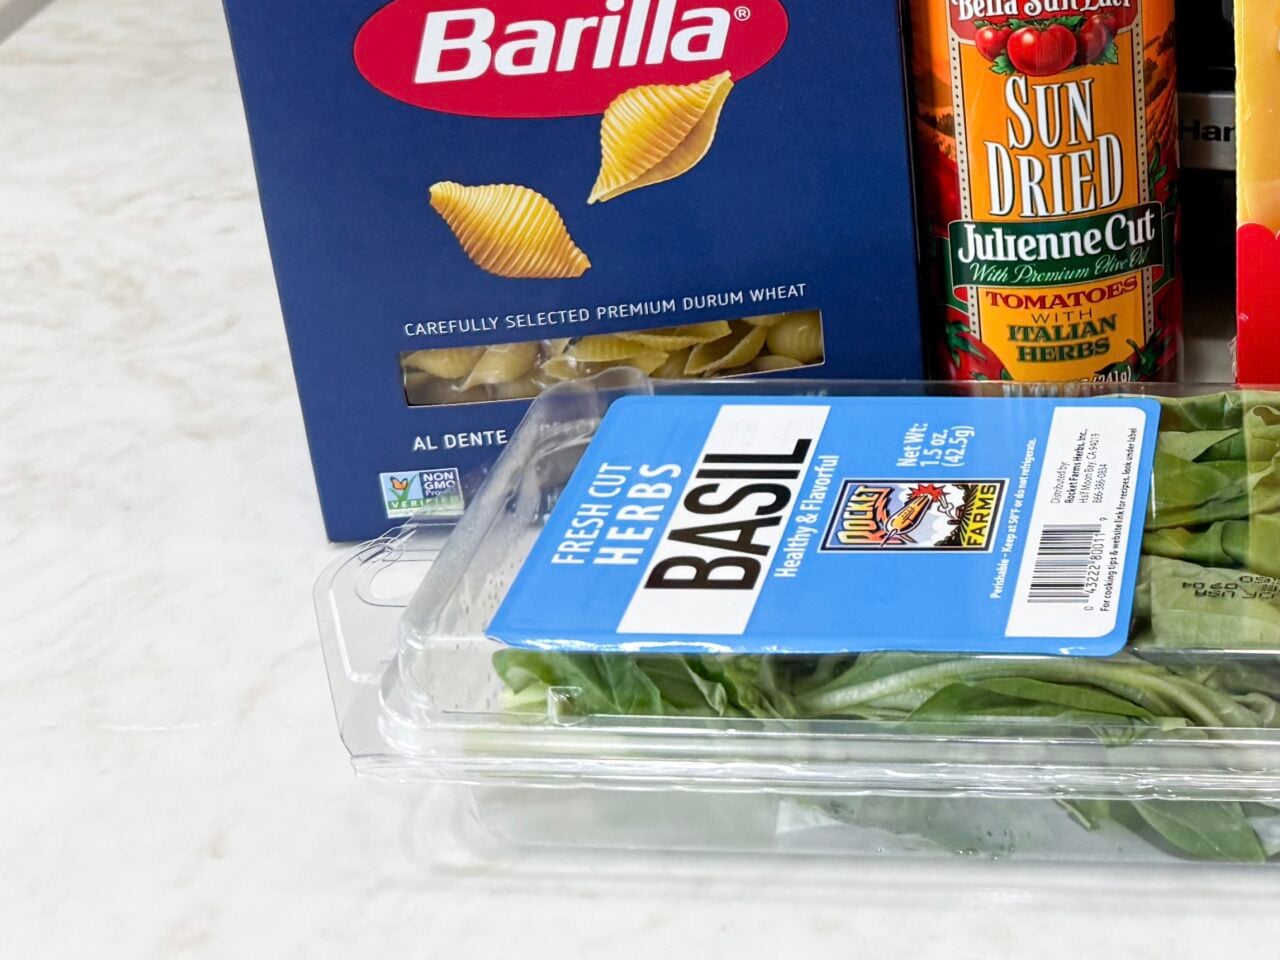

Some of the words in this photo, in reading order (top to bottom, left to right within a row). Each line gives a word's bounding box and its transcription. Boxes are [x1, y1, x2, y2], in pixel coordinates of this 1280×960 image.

[1003, 74, 1095, 150] SUN
[983, 133, 1125, 218] DRIED
[957, 222, 1104, 264] Julienne
[1104, 209, 1156, 250] Cut
[968, 262, 1009, 283] With
[1009, 263, 1090, 285] Premium
[985, 275, 1138, 310] TOMATOES
[404, 316, 500, 337] CAREFULLY
[505, 307, 590, 329] SELECTED
[596, 298, 677, 320] PREMIUM
[682, 290, 745, 310] DURUM
[749, 283, 807, 303] WHEAT
[1031, 308, 1093, 324] WITH
[1007, 313, 1119, 343] ITALIAN
[1016, 336, 1111, 364] HERBS
[413, 434, 441, 451] AL
[444, 429, 509, 448] DENTE
[930, 429, 949, 447] oz.
[941, 425, 976, 468] (42.5g)
[896, 445, 922, 468] Net
[920, 448, 944, 468] 1.5
[423, 471, 454, 481] NON
[424, 480, 456, 490] GMO
[799, 455, 840, 512] Flavorful
[550, 503, 614, 565] FRESH
[587, 462, 633, 498] CUT
[592, 463, 682, 566] HERBS
[643, 438, 813, 590] BASIL
[795, 514, 819, 525] &
[966, 484, 996, 547] FARMS
[773, 526, 819, 578] Healthy
[1111, 525, 1123, 550] website
[989, 558, 1010, 599] Perishable
[1001, 533, 1018, 553] Keep
[1085, 564, 1101, 594] 43222
[1104, 570, 1117, 600] cooking
[1100, 601, 1111, 612] For
